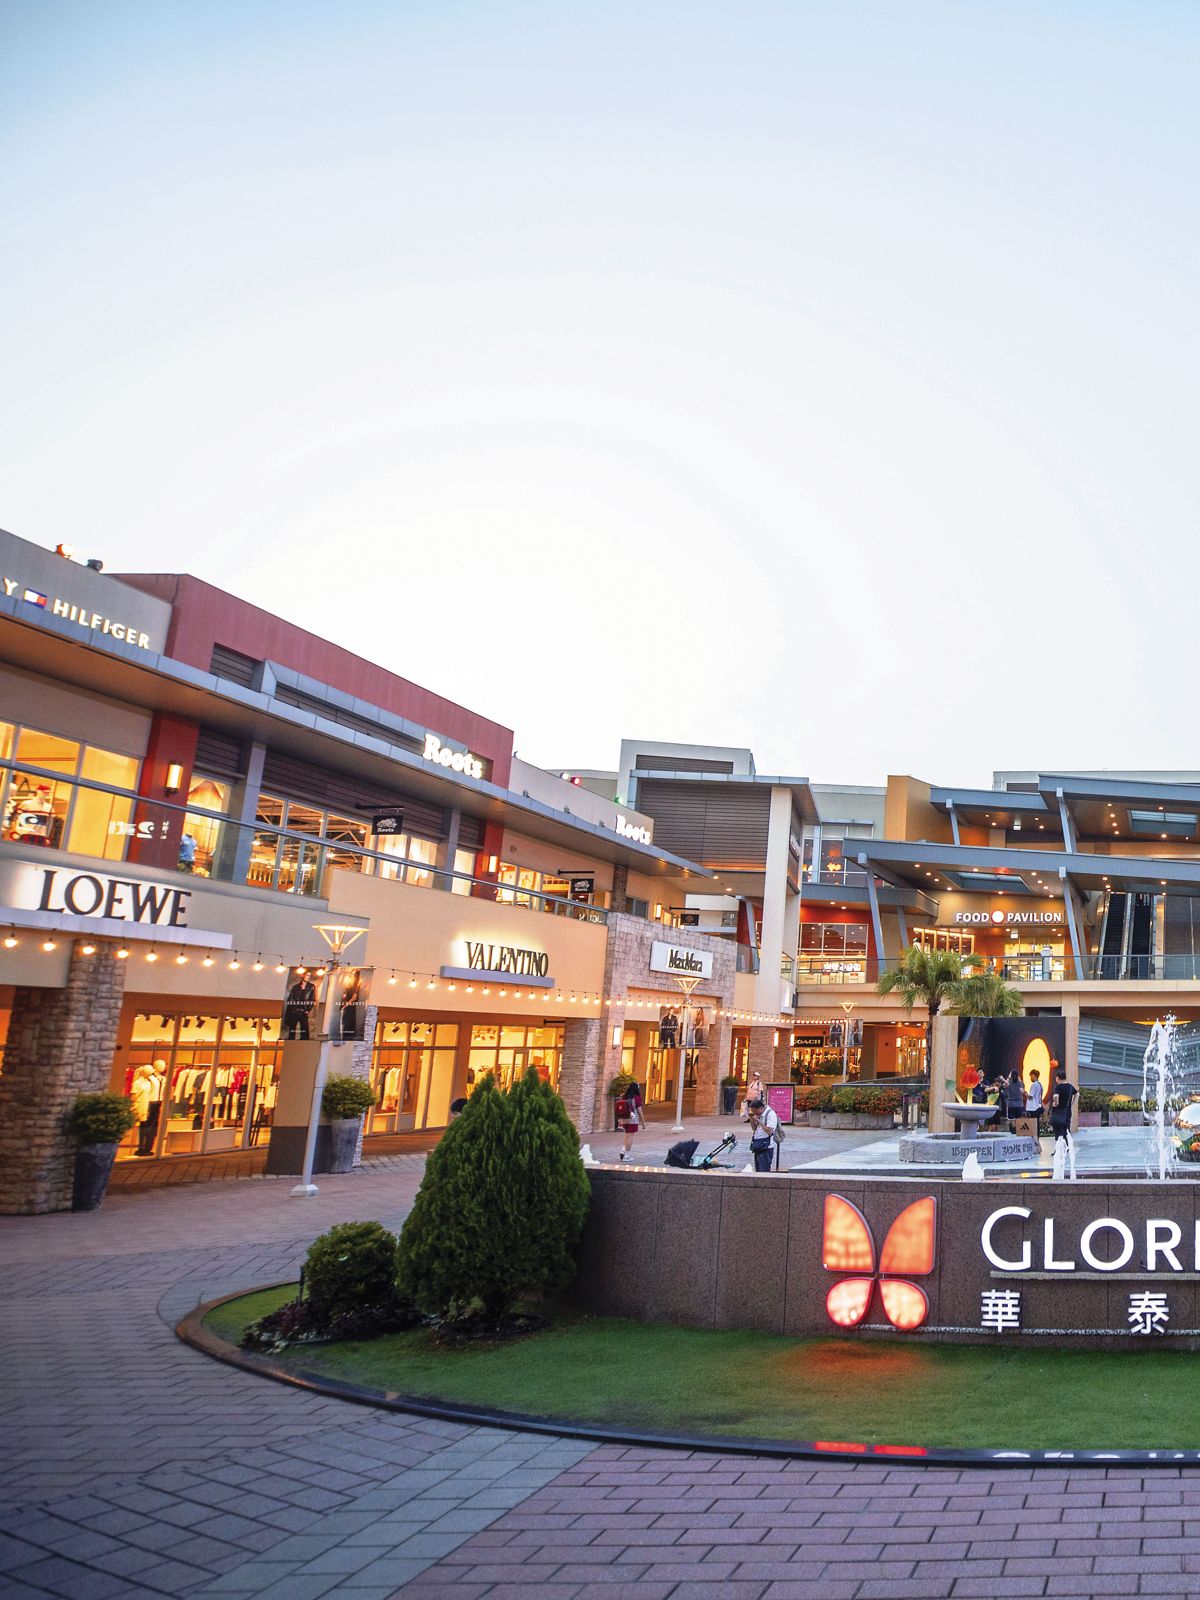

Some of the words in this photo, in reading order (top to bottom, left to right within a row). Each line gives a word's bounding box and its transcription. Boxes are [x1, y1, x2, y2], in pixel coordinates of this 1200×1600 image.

[52, 598, 150, 650] HILFIGER
[423, 733, 483, 779] Roots
[615, 814, 650, 846] Roots
[37, 870, 192, 928] LOEWE
[956, 912, 989, 923] FOOD
[1007, 912, 1062, 922] PAVILION
[464, 941, 549, 977] VALENTINO
[668, 949, 703, 973] MaxMara
